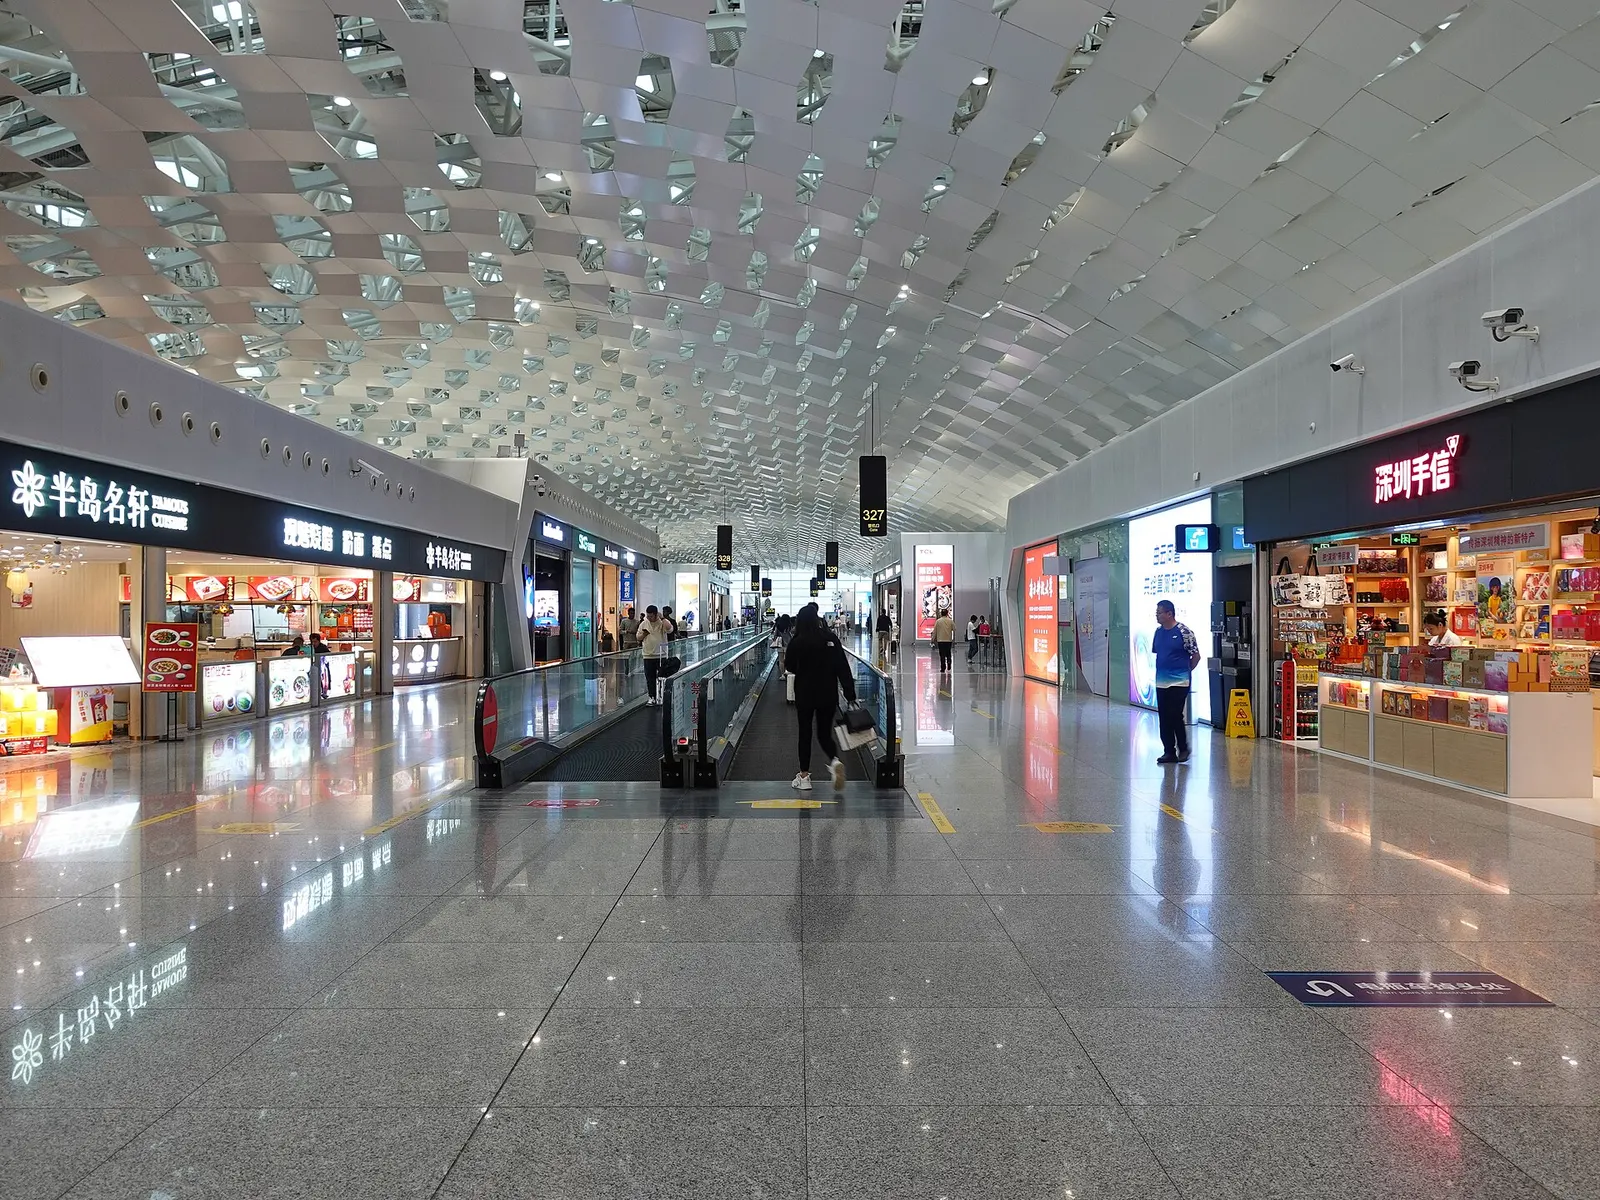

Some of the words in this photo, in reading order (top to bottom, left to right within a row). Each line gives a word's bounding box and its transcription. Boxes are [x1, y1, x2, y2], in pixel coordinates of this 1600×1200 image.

[1375, 449, 1450, 504] 深圳手信
[49, 471, 150, 528] 半岛名轩
[151, 494, 189, 514] FAMOUS
[151, 513, 188, 531] CUISINE
[862, 509, 885, 521] 327
[341, 530, 365, 557] 粉面
[718, 554, 731, 562] 328
[918, 566, 941, 575] 第四代
